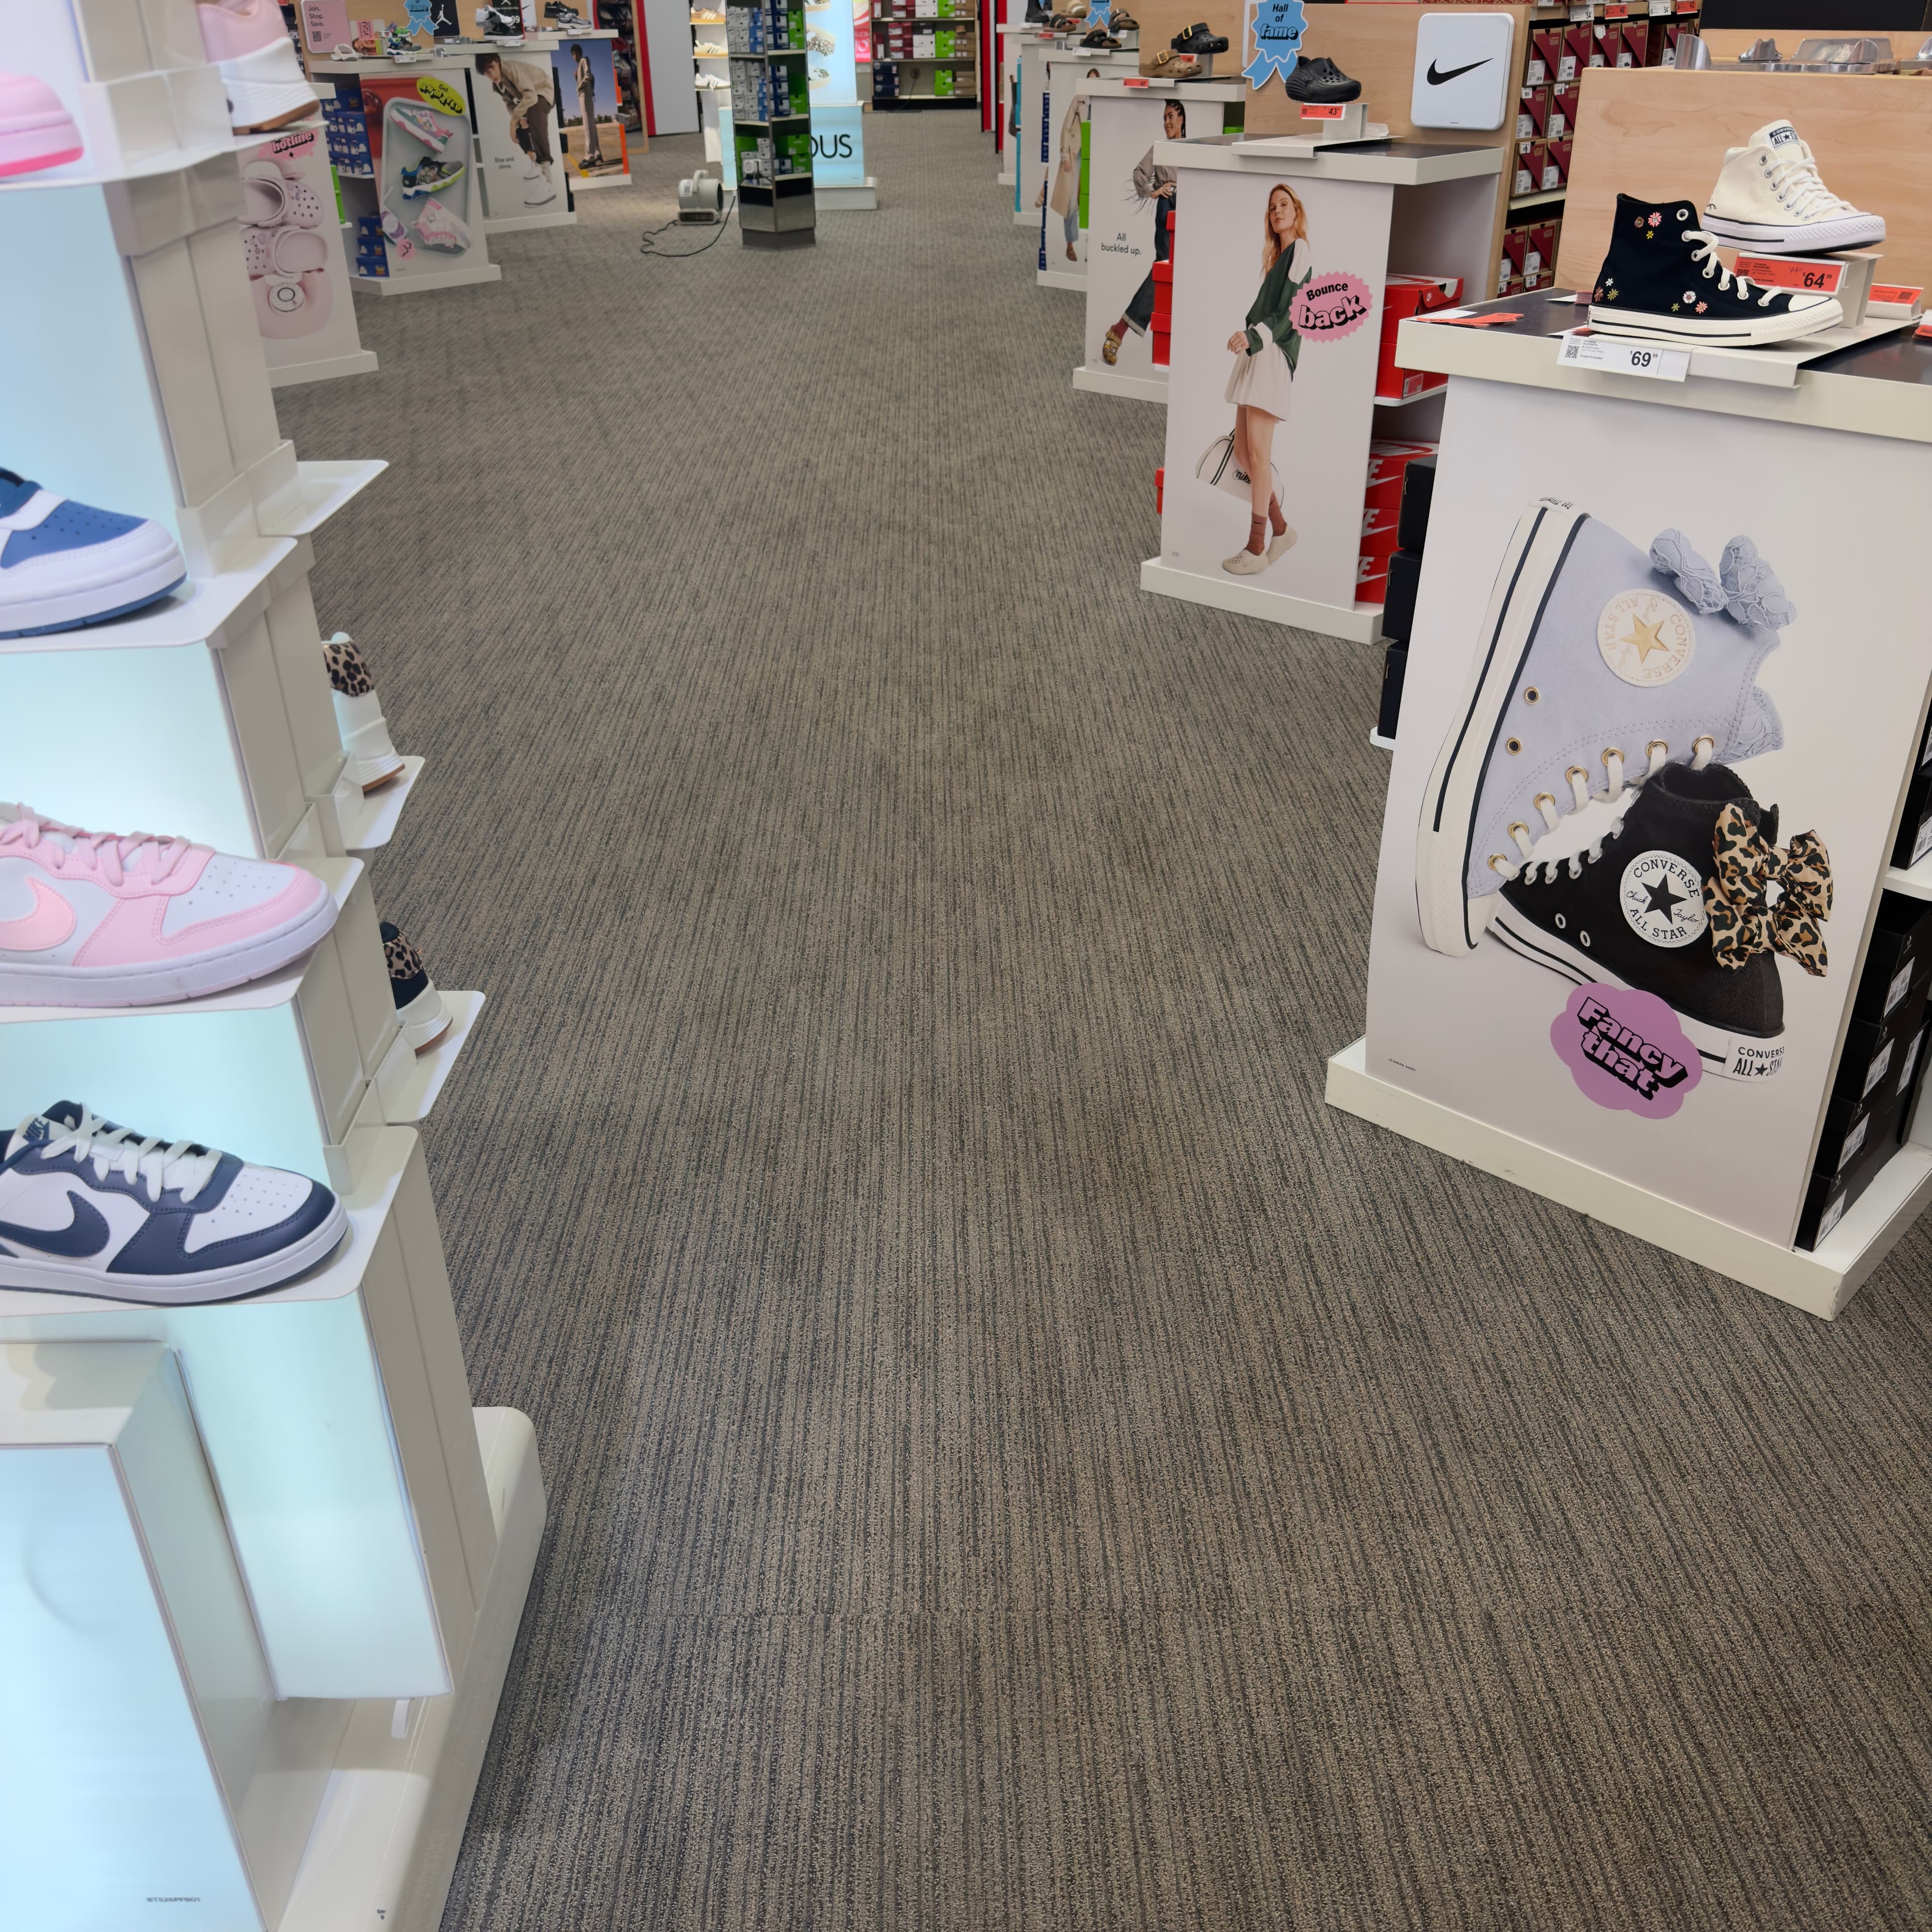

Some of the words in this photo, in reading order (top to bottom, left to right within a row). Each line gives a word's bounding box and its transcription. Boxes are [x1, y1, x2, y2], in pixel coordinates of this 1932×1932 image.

[1272, 4, 1289, 12] Hall
[1275, 14, 1284, 22] of
[1260, 23, 1298, 40] fame
[272, 132, 314, 153] hotline
[1774, 135, 1784, 146] ALL
[1116, 232, 1126, 242] All
[1101, 242, 1129, 253] buckled
[1131, 248, 1142, 257] up.
[1306, 283, 1348, 301] Bounce
[1298, 295, 1367, 330] back
[1634, 859, 1700, 898] CONVERSE
[1626, 891, 1648, 904] Chuck
[1630, 909, 1647, 931] ALL
[1652, 926, 1687, 939] STAR
[1673, 909, 1700, 923] Taylor
[1577, 997, 1688, 1088] Fancy
[1738, 1046, 1785, 1059] CONVERSE
[1581, 1025, 1660, 1101] that
[1732, 1058, 1754, 1076] ALL
[23, 1117, 44, 1141] NIKE
